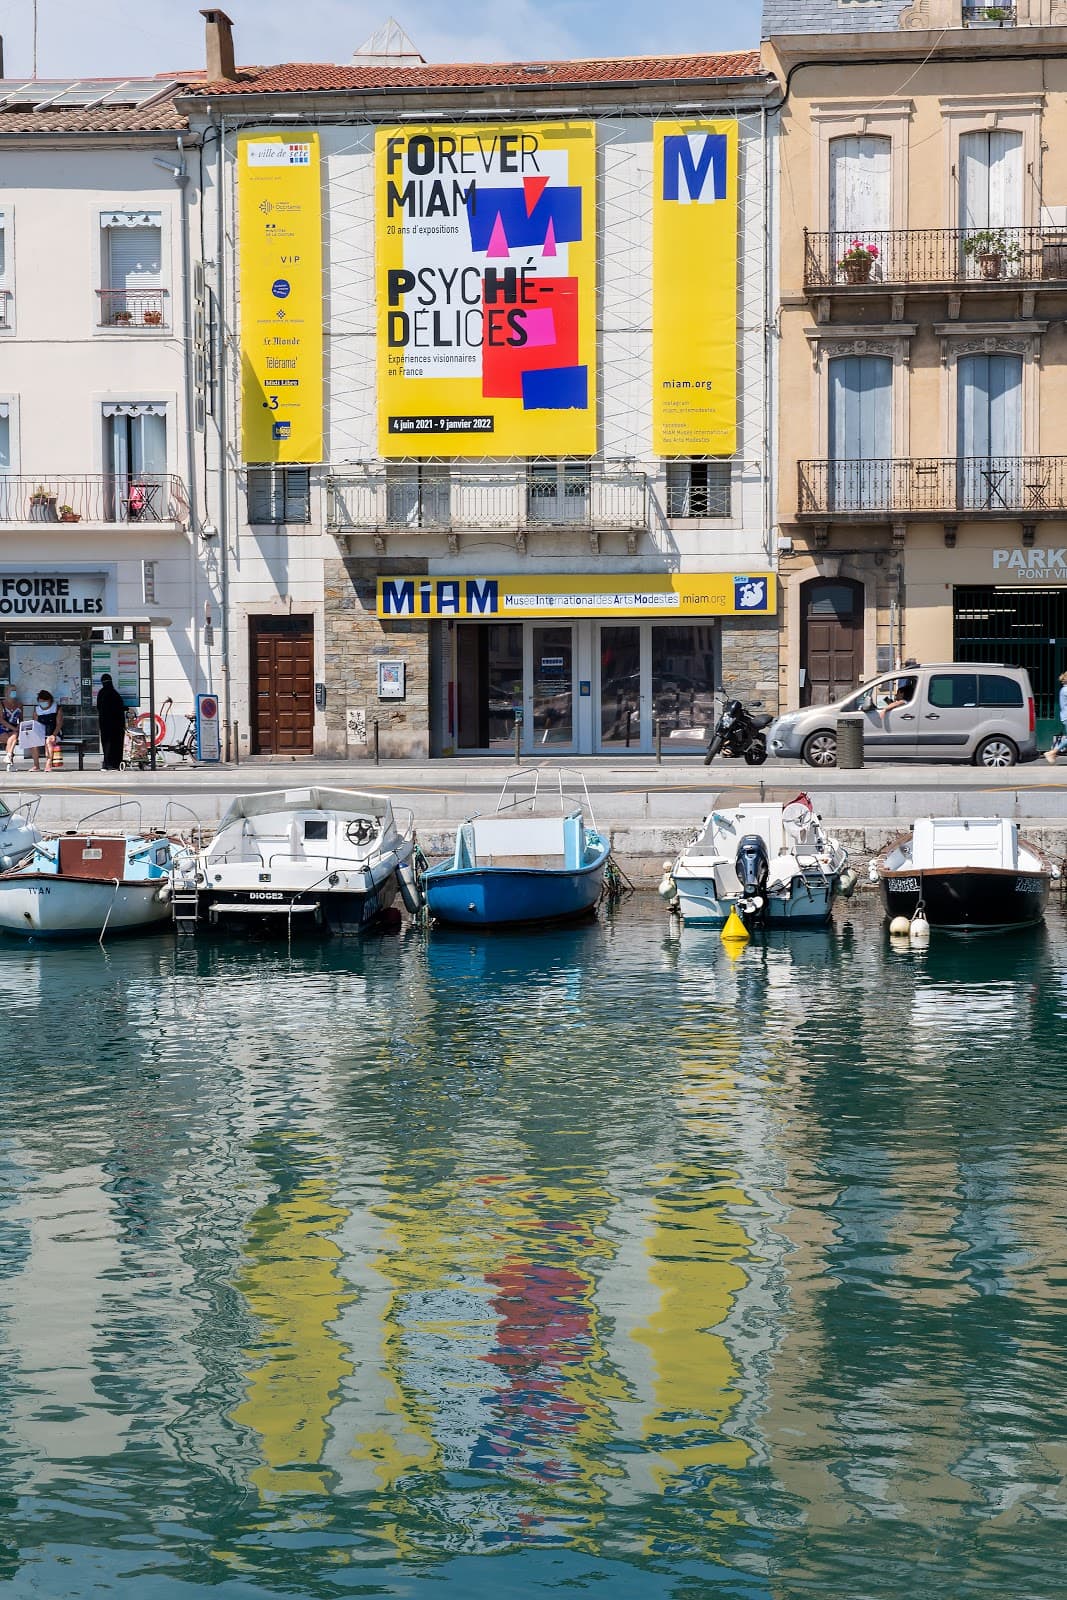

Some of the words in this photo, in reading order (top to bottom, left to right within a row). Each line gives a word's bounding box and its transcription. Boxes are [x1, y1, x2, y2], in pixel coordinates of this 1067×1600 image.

[387, 133, 540, 176] FOREVER
[387, 179, 477, 218] MIAM
[387, 225, 396, 235] 20
[397, 226, 411, 235] ans
[412, 224, 459, 237] d'expositions
[387, 257, 554, 306] PSYCHÉ-
[388, 308, 528, 348] DÉLICES
[273, 336, 300, 346] Monde
[388, 355, 432, 365] Expériences
[433, 354, 477, 363] visionnaires
[399, 367, 424, 376] France
[662, 379, 713, 391] miam.org
[393, 420, 399, 429] 4
[400, 419, 415, 430] juin
[416, 419, 433, 428] 2021
[440, 419, 445, 428] 9
[445, 418, 472, 429] janvier
[473, 418, 491, 428] 2022
[992, 549, 1067, 568] PARK
[1018, 569, 1051, 579] PONT
[2, 579, 70, 597] FOIRE
[0, 598, 104, 614] OUVAILLES
[504, 594, 535, 606] Musée
[536, 594, 595, 606] International
[596, 594, 613, 605] des
[614, 594, 634, 605] Arts
[634, 593, 679, 605] Modestes
[682, 593, 726, 606] miam.org
